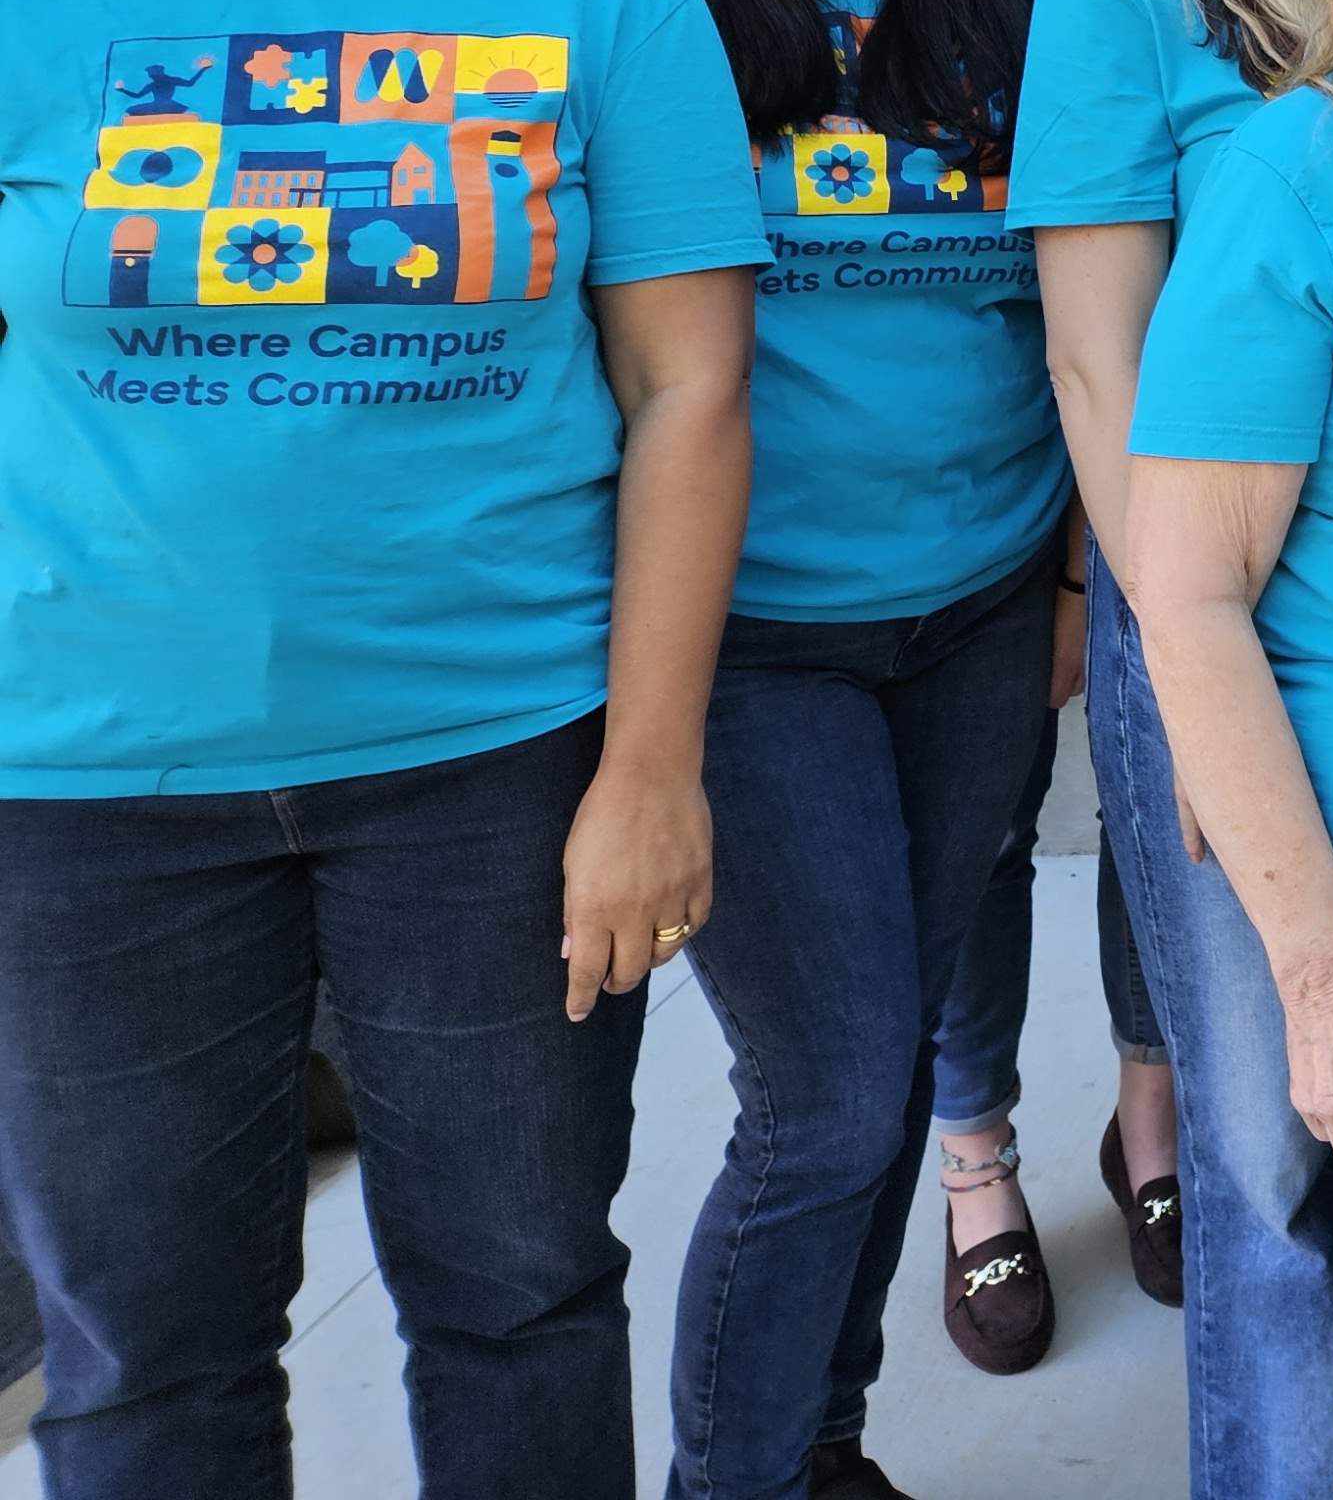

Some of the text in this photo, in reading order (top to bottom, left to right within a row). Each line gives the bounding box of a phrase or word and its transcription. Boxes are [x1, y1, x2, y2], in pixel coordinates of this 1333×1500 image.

[766, 230, 1036, 258] here Campus
[754, 261, 1038, 295] ets Community
[106, 323, 507, 366] Where Campus
[76, 363, 529, 407] Meets Community
